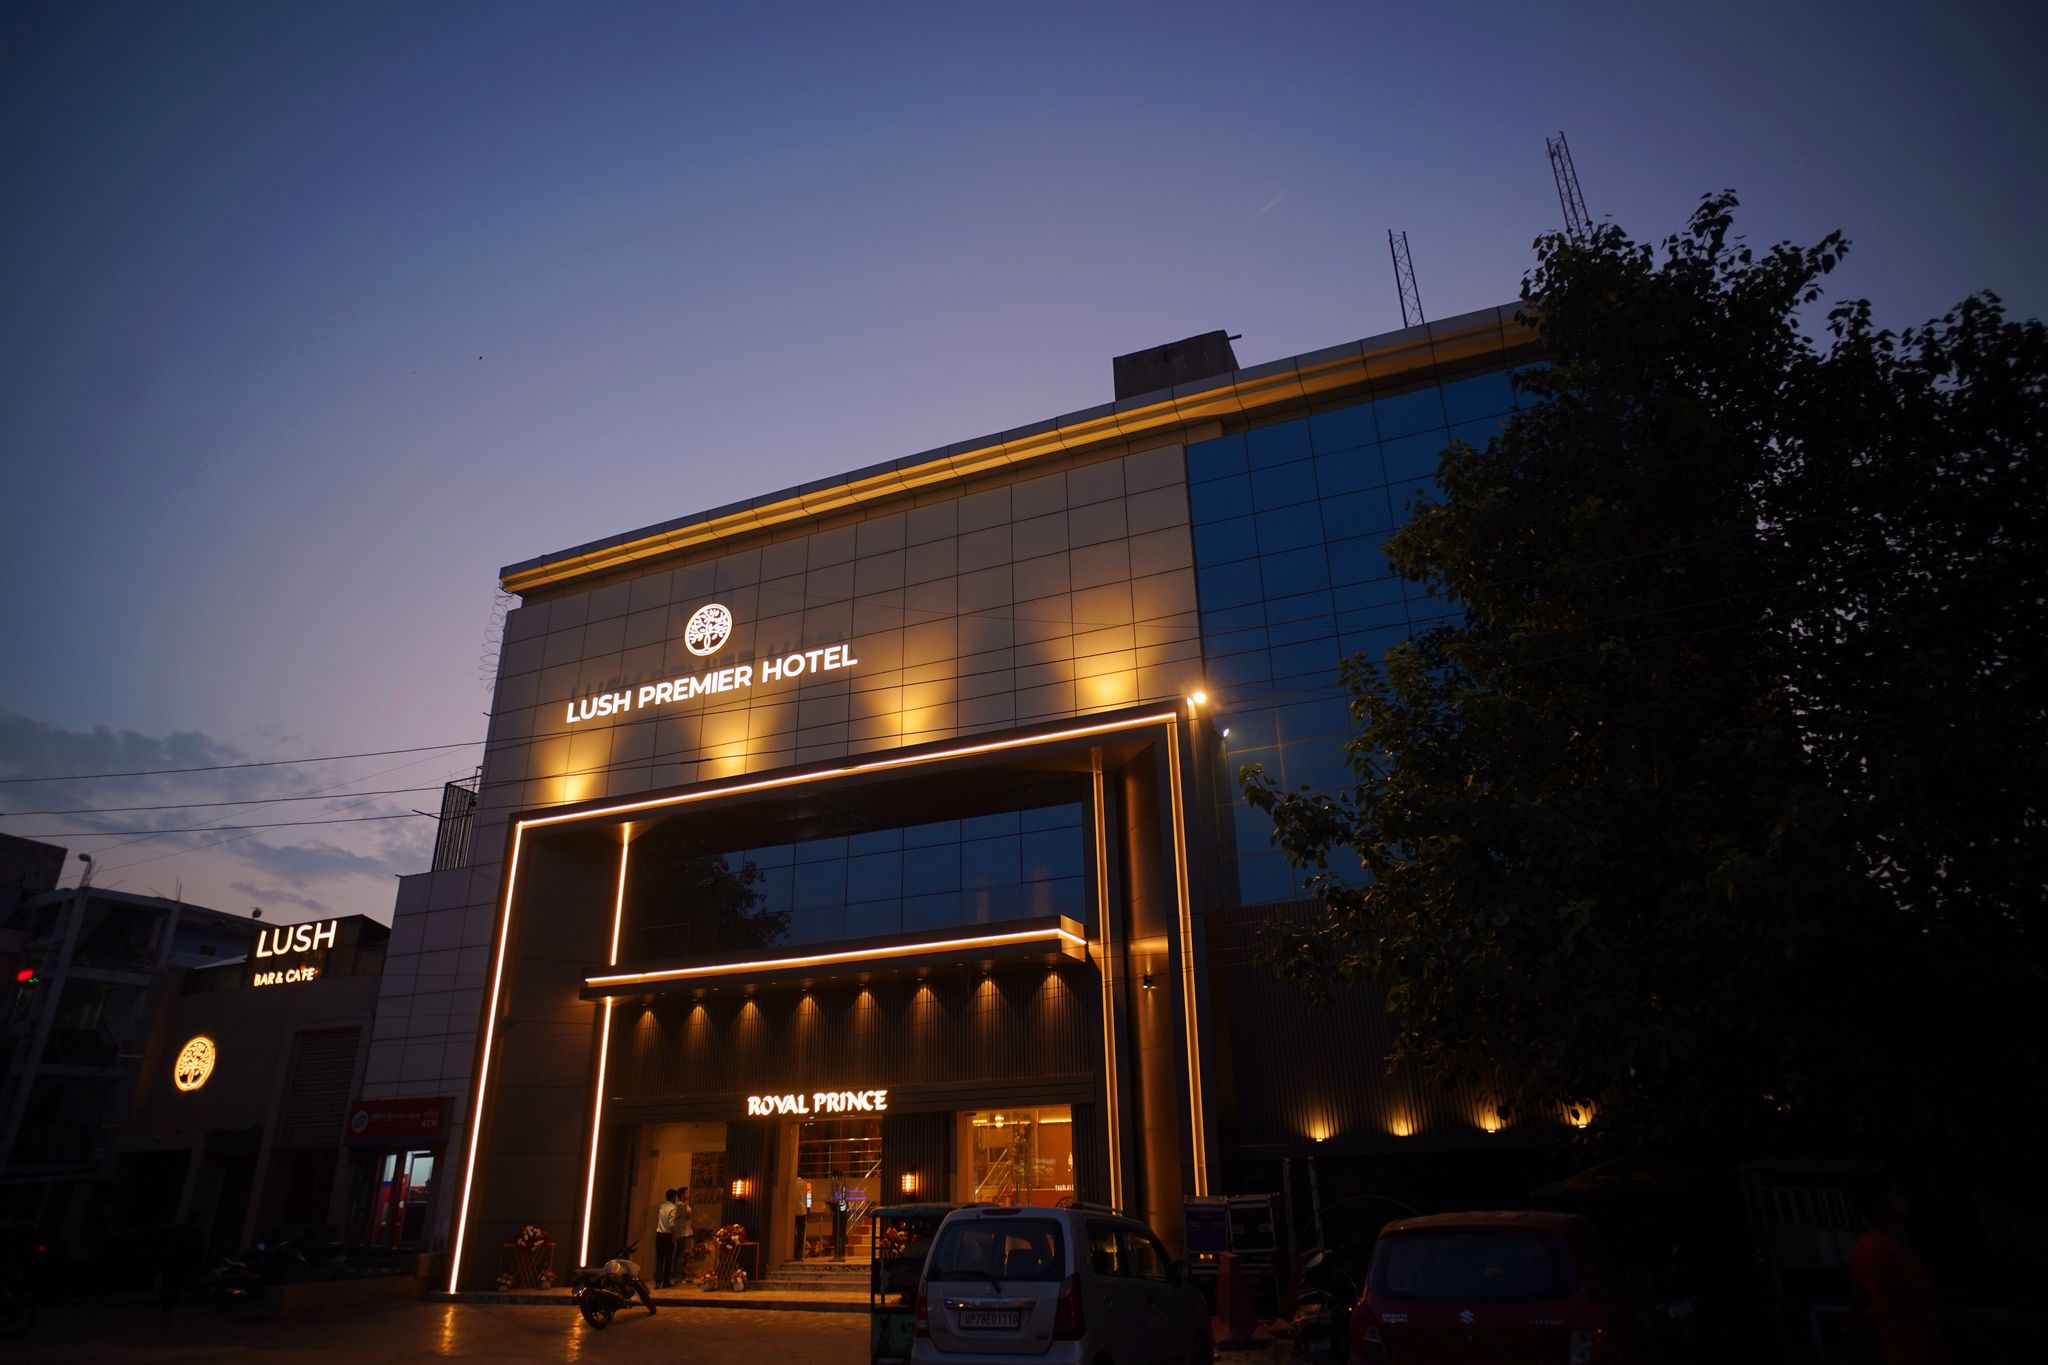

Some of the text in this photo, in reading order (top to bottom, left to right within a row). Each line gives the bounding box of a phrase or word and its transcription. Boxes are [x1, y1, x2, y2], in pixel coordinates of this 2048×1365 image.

[565, 644, 859, 723] LUSH PREMIER HOTEL
[256, 920, 337, 958] LUSH
[254, 967, 315, 986] BAR & CAFE
[747, 1090, 888, 1116] ROYAL PRINCE
[421, 1119, 439, 1129] ATM
